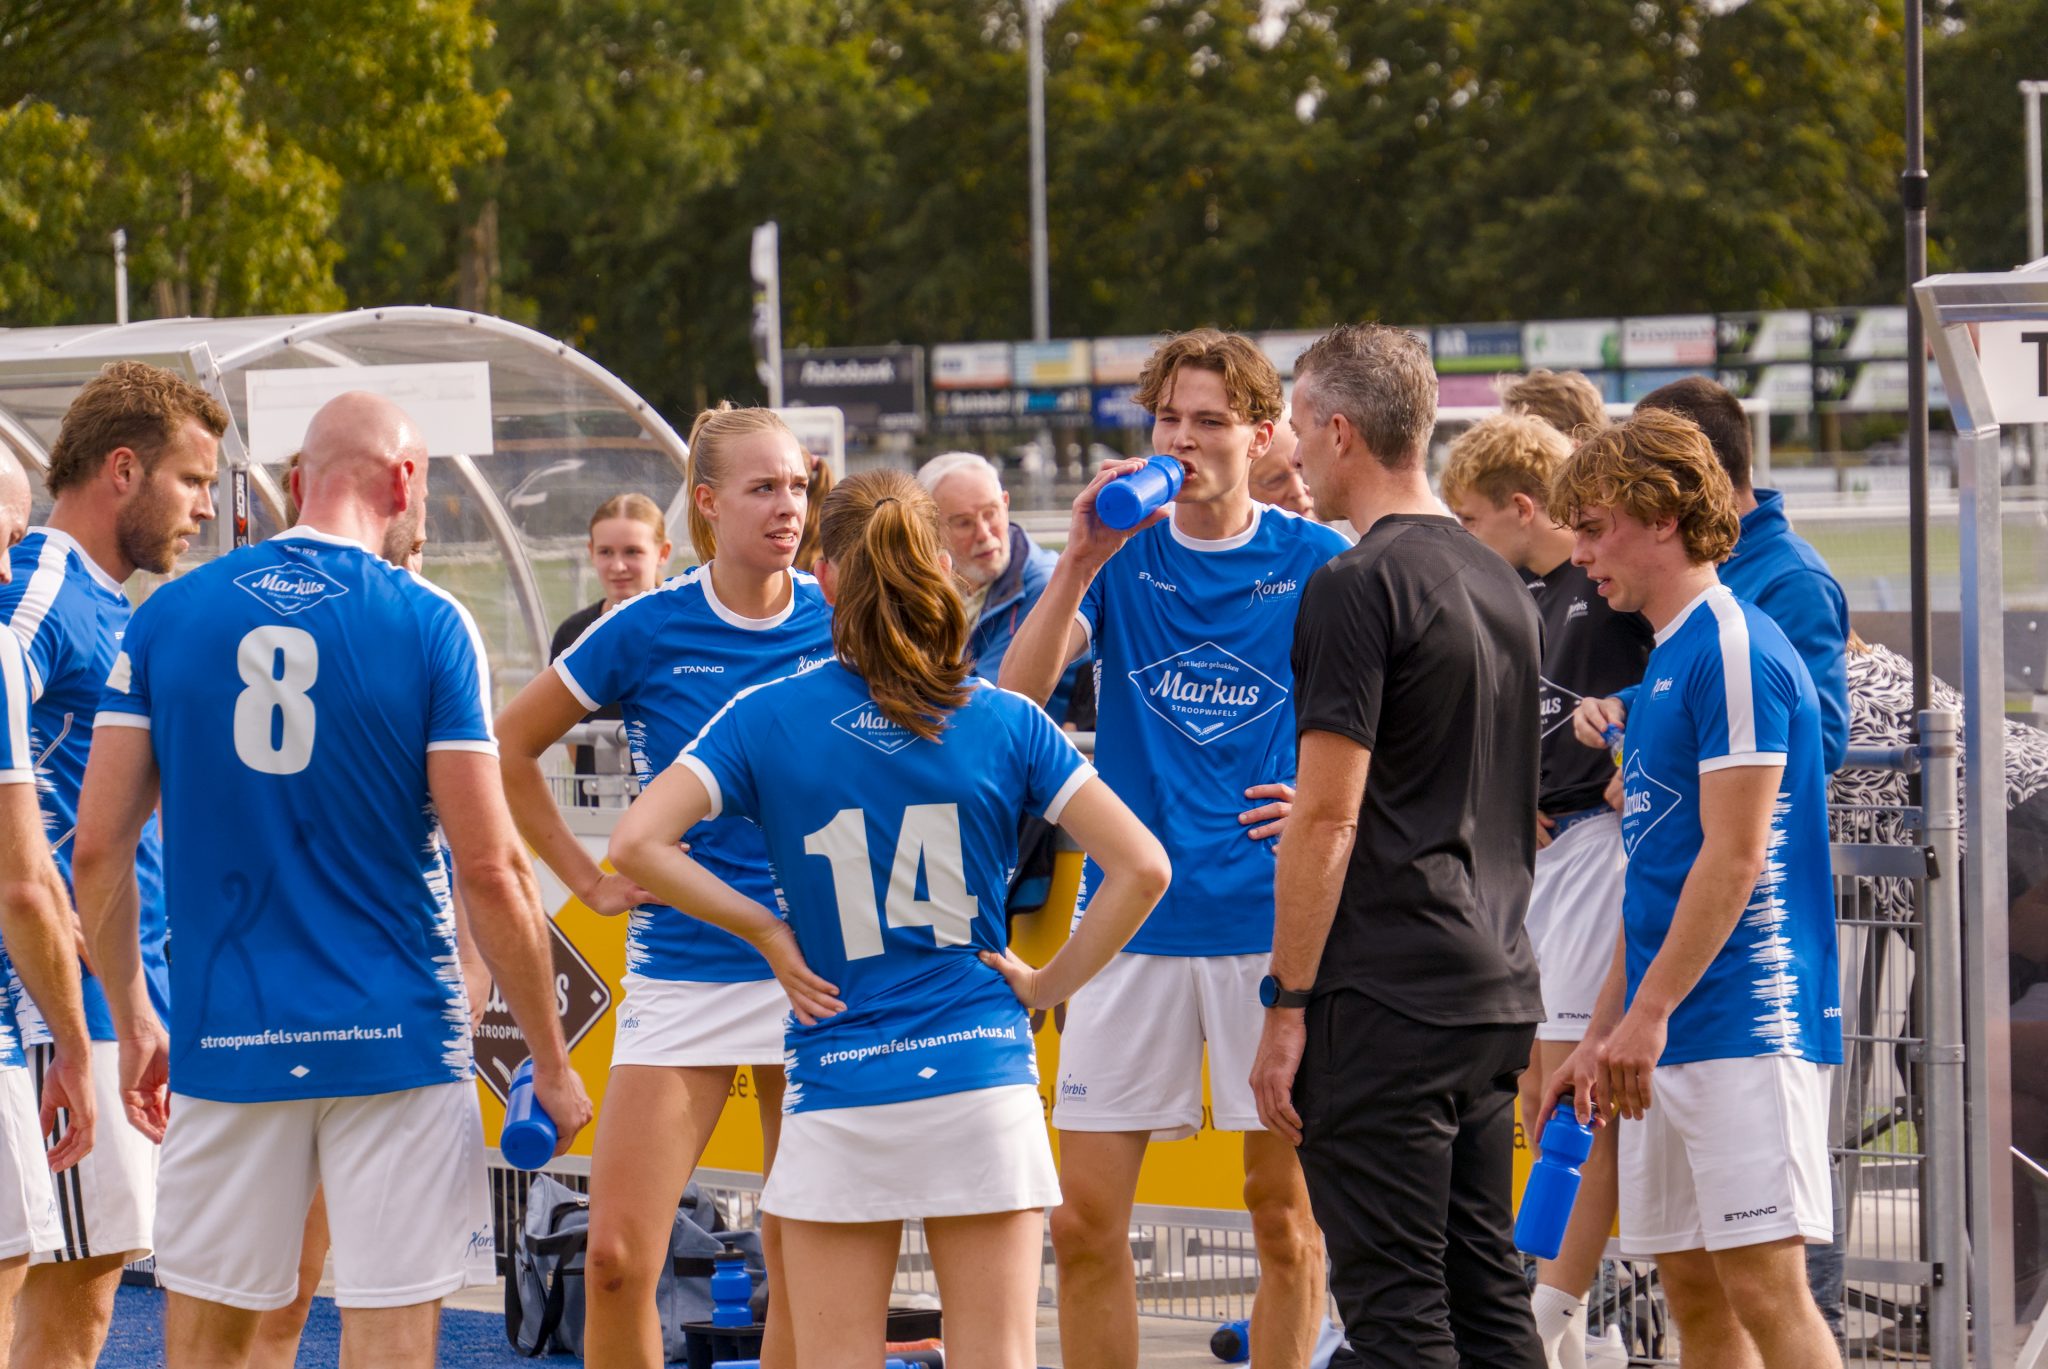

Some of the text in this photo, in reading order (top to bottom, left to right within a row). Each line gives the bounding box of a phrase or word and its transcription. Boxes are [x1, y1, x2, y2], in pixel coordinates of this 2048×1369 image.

[251, 573, 326, 595] Markus
[672, 665, 725, 675] STANNO
[1150, 670, 1260, 706] Markus
[233, 625, 319, 775] 8
[1171, 704, 1238, 717] STROOPWAFELS
[803, 803, 979, 961] 14
[1724, 1205, 1778, 1222] STANNO
